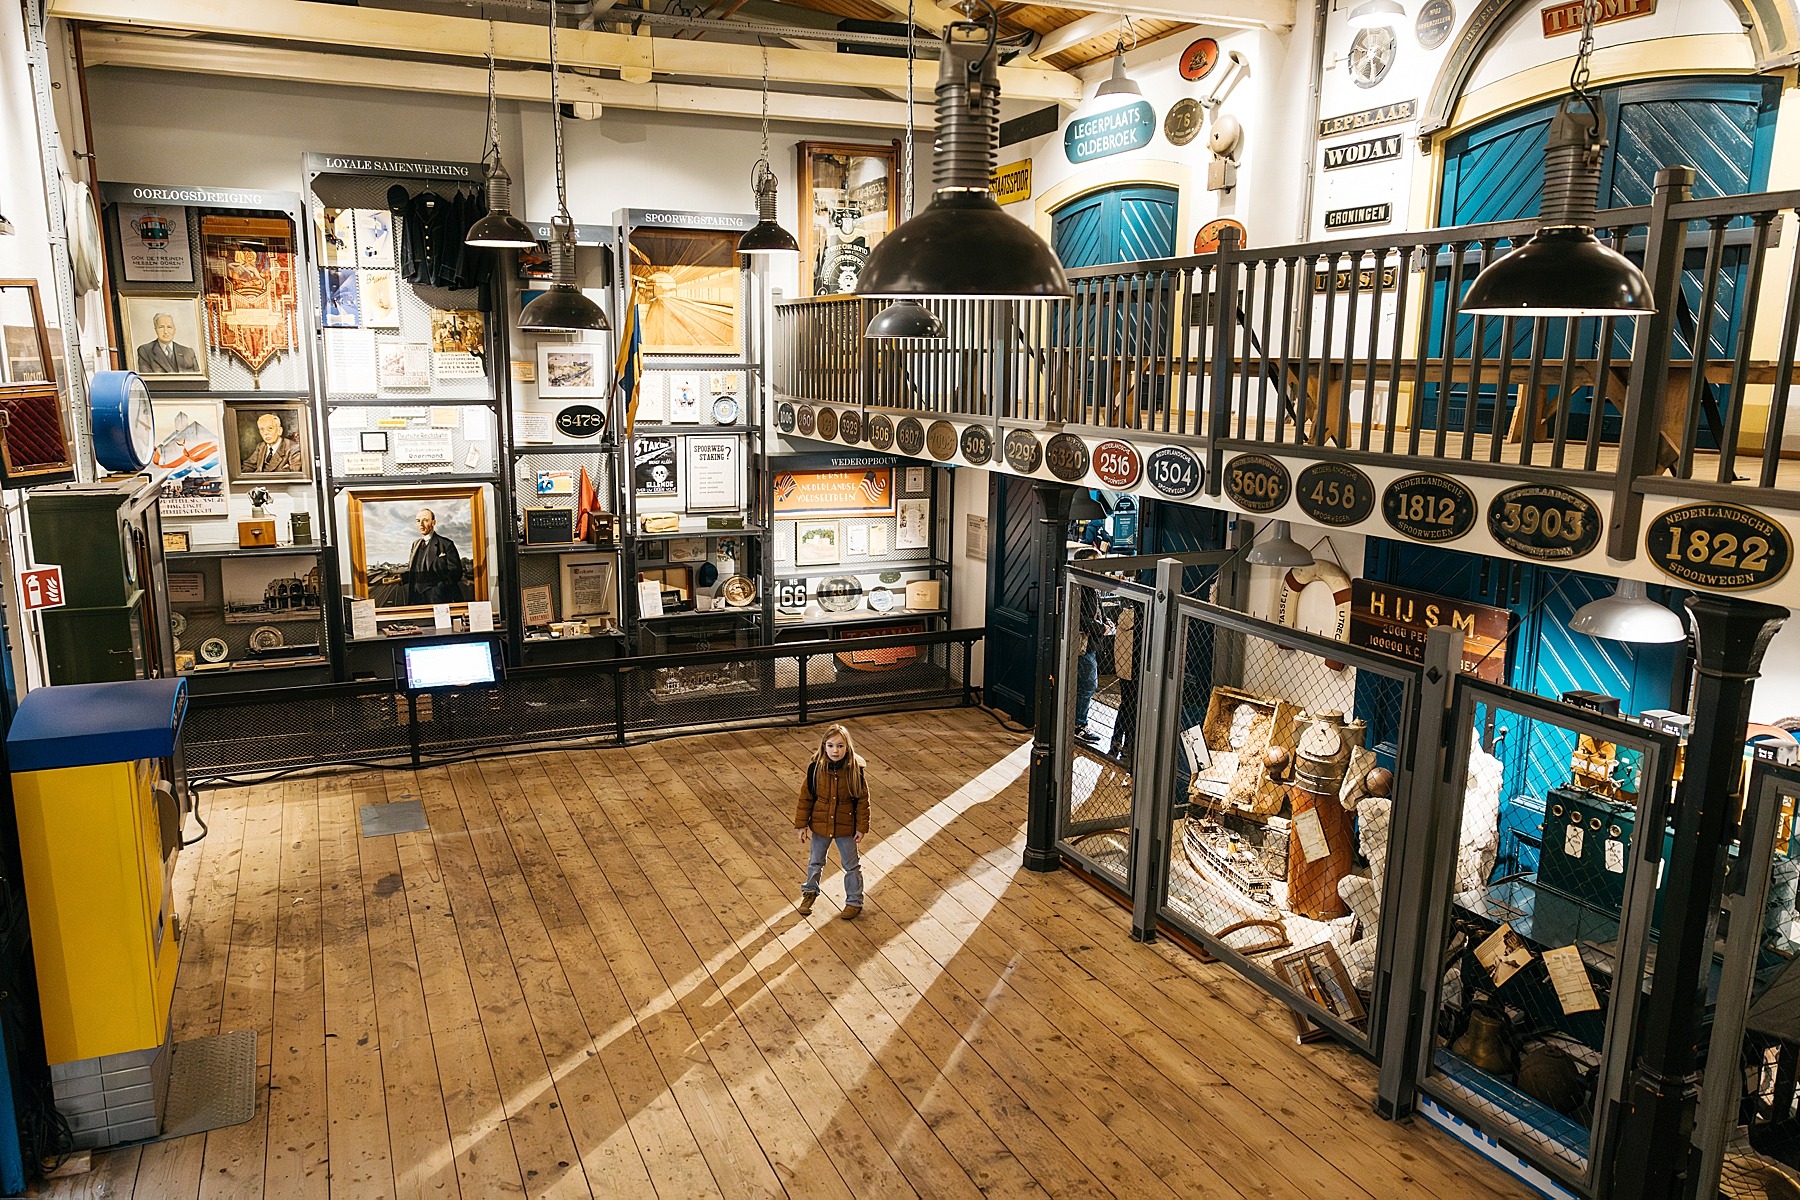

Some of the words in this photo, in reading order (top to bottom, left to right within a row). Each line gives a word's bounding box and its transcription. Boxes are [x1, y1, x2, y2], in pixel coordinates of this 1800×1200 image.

[1074, 107, 1140, 140] LEGERPLAATS
[1176, 112, 1190, 129] 76
[1324, 102, 1410, 134] LEPELAAR
[1076, 128, 1138, 157] OLDEBROEK
[1326, 138, 1398, 166] WODAN
[326, 158, 372, 170] LOYALE
[374, 161, 469, 176] SAMENWERKING
[133, 188, 262, 204] OORLOGSDREIGING
[645, 213, 744, 227] SPOORWEGSTAKING
[1329, 205, 1386, 225] GRONINGEN
[562, 414, 600, 427] 8478
[871, 426, 889, 442] 1506
[694, 445, 724, 453] SPOORWEG
[966, 436, 985, 454] 508
[1008, 441, 1036, 462] 2293
[831, 456, 899, 466] WEDEROPBOUW
[1051, 448, 1082, 470] 6320
[1100, 452, 1130, 476] 2516
[1156, 448, 1192, 464] NEDERLANDSCHE
[1154, 460, 1192, 486] 1304
[801, 482, 856, 492] NEDERLANDSE
[1158, 482, 1186, 494] SPOORWEGEN
[1230, 470, 1280, 500] 3606
[1310, 480, 1356, 509] 458
[1394, 476, 1464, 498] NEDERLANDSCHE
[796, 494, 856, 502] VOEDSELTREIN
[1313, 509, 1350, 522] SPOORWEGEN
[1398, 493, 1456, 526] 1812
[1398, 521, 1454, 538] SPOORWEGEN
[1500, 502, 1584, 542] 3903
[1665, 508, 1774, 536] NEDERLANDSCHE
[1666, 526, 1769, 572] 1822
[1668, 562, 1754, 585] SPOORWEGEN
[781, 586, 806, 606] 66
[1382, 623, 1406, 638] 2000
[1370, 634, 1402, 653] 100000
